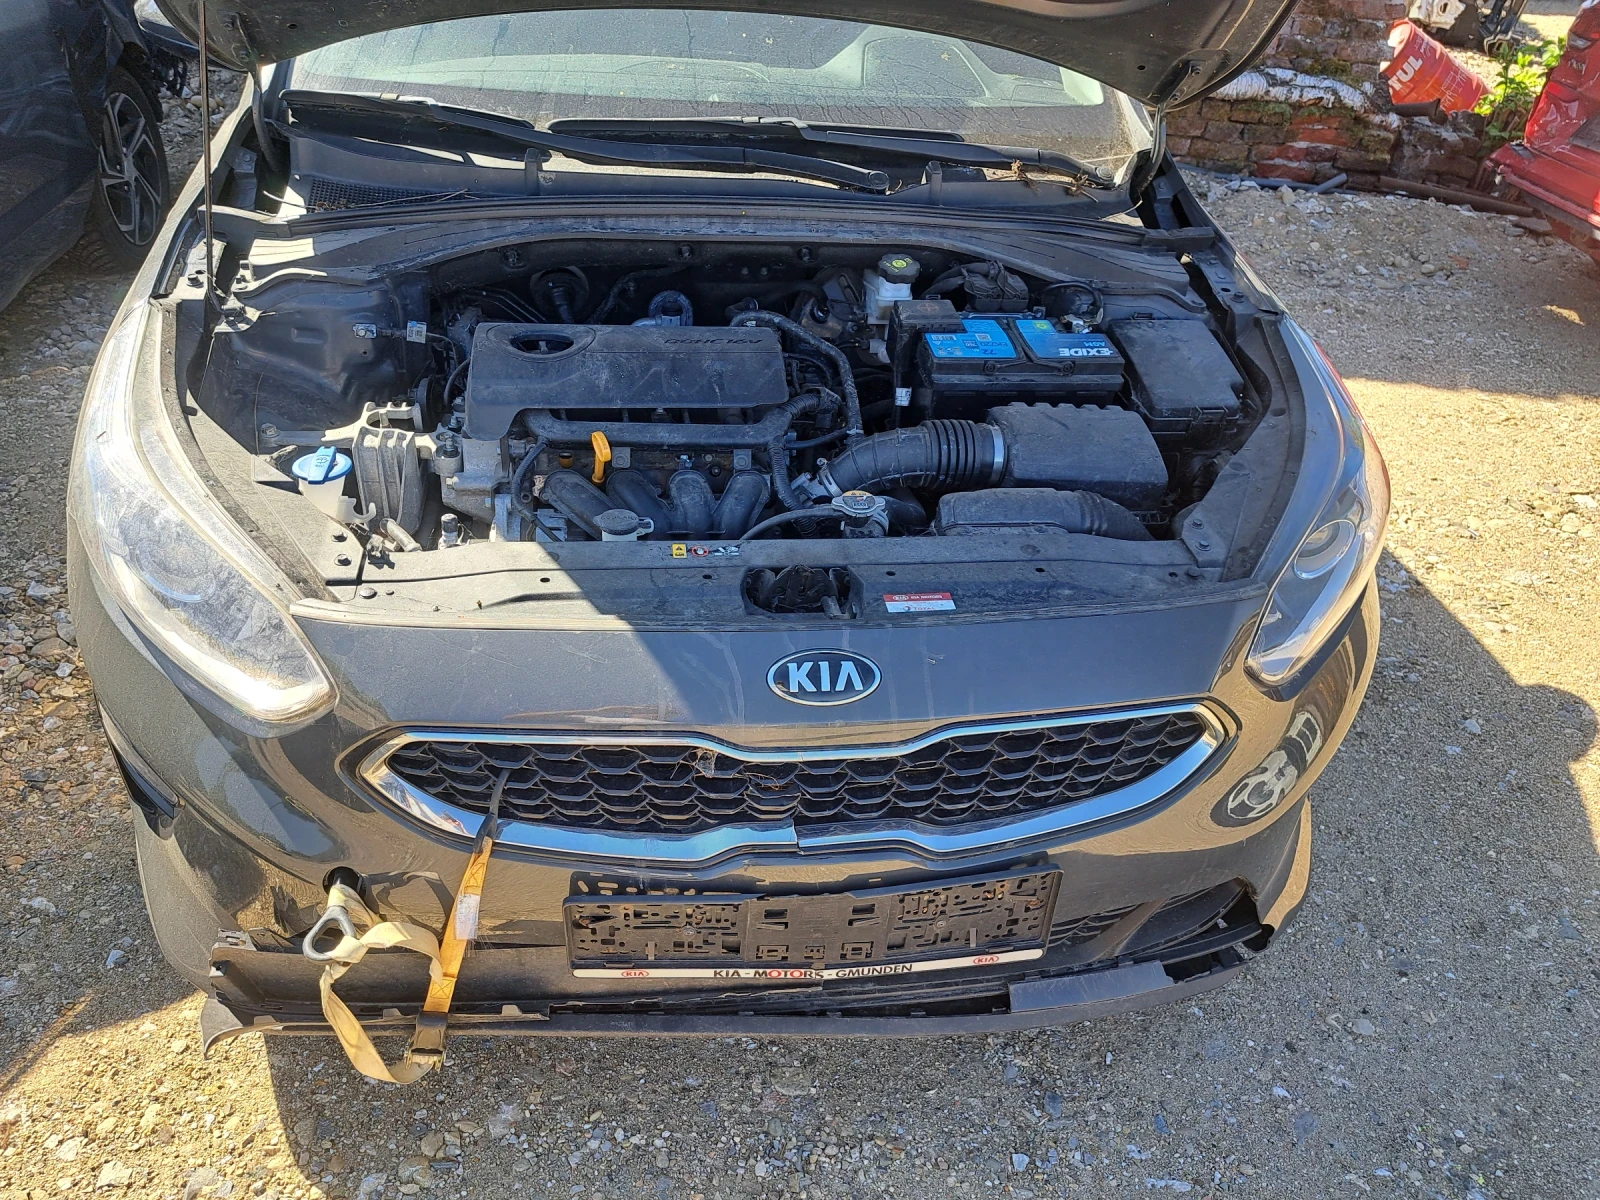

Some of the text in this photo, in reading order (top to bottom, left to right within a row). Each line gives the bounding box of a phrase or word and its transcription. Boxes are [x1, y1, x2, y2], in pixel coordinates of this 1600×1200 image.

[1059, 347, 1113, 357] EXIDE
[786, 660, 864, 693] KIA
[977, 956, 996, 964] KIA
[713, 969, 741, 978] KIA
[753, 969, 825, 980] MOTORS
[835, 963, 913, 979] GMUNDEN
